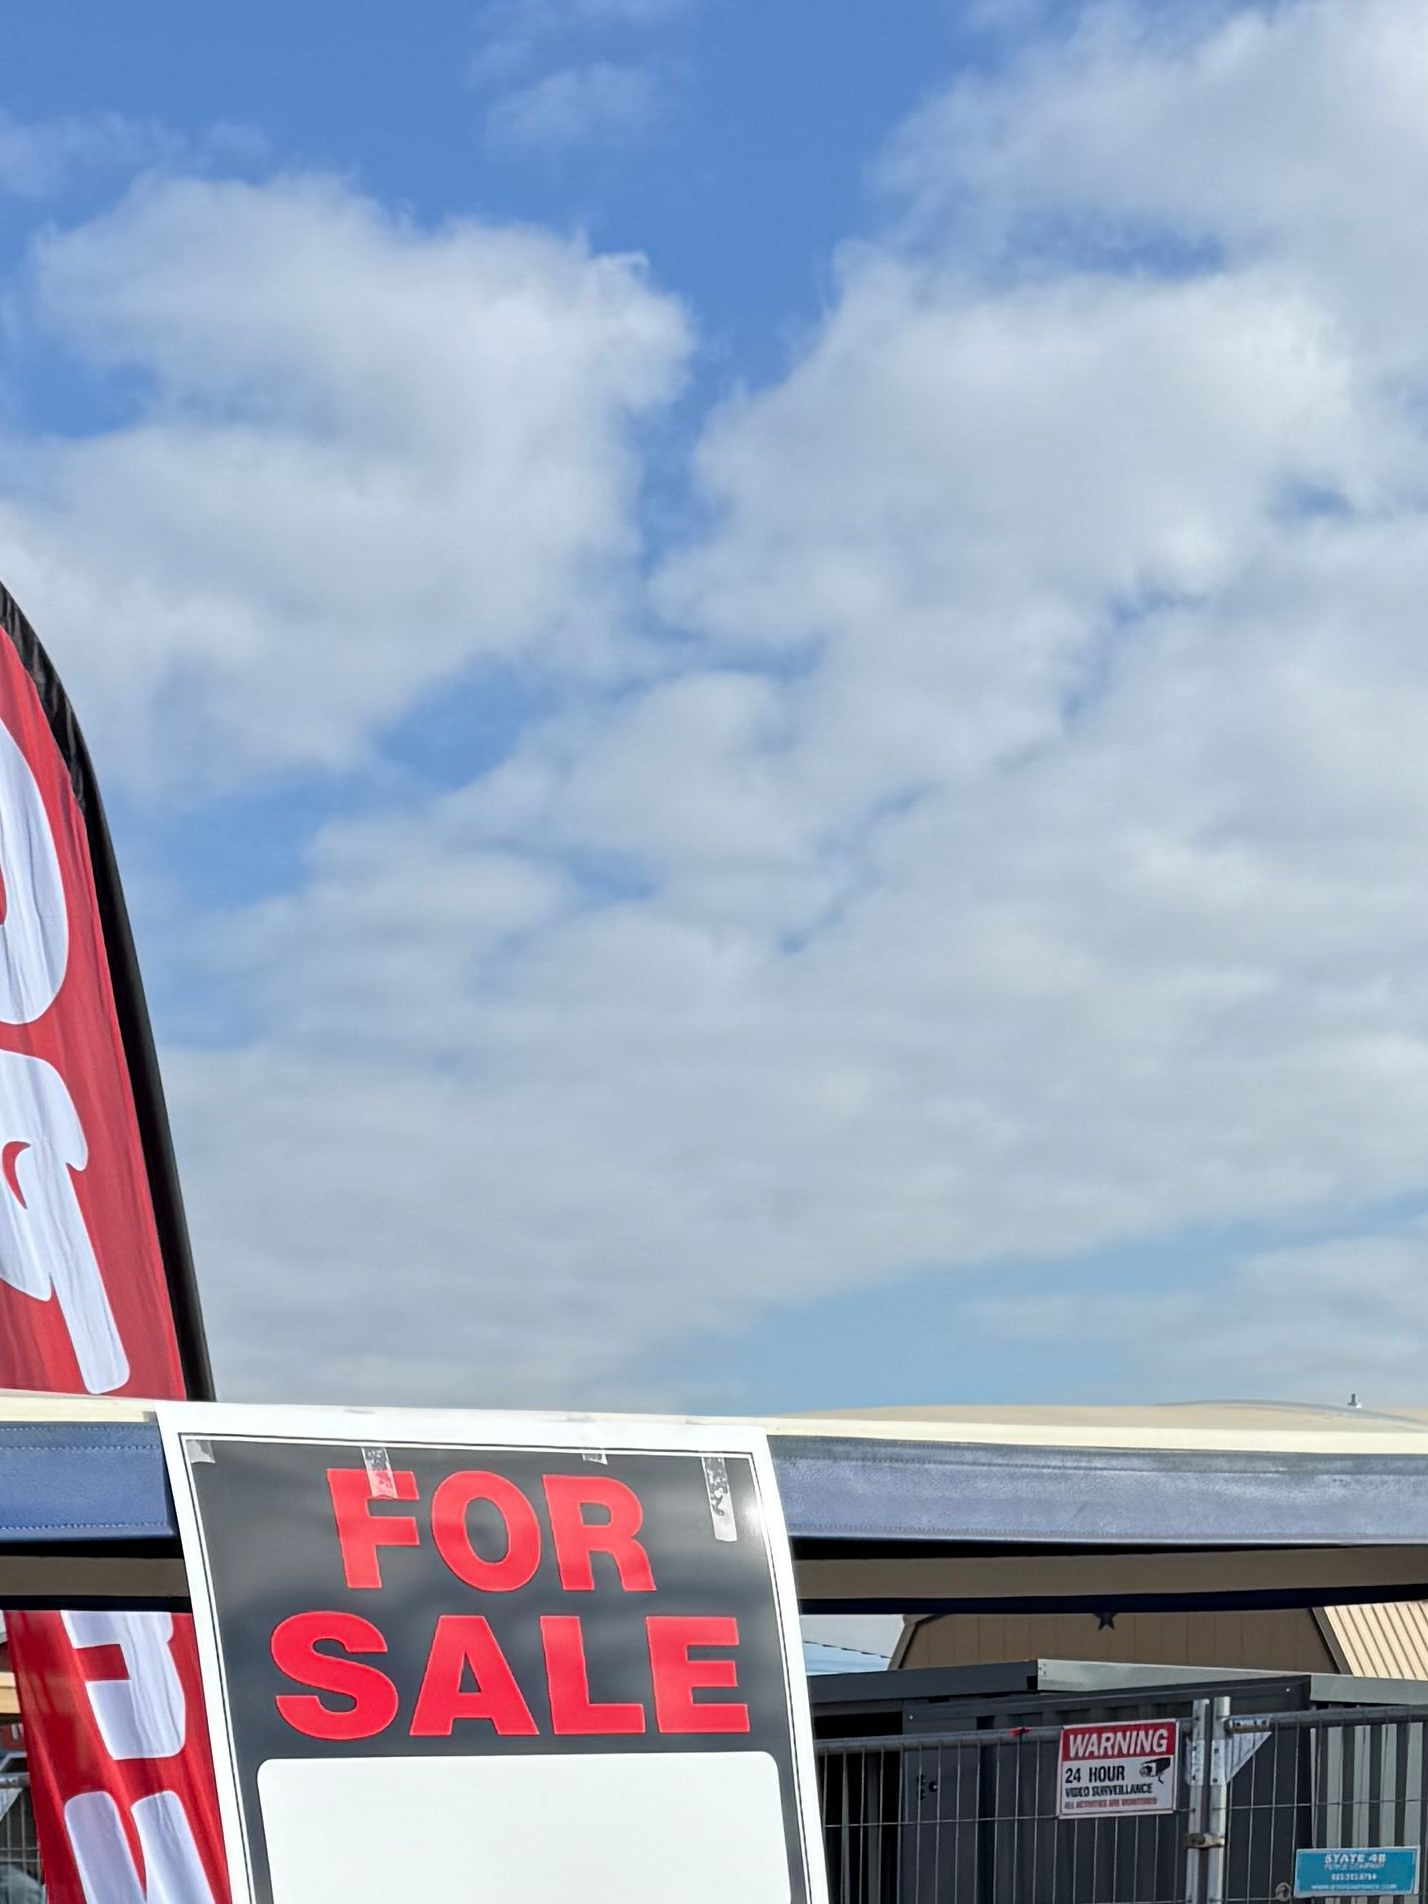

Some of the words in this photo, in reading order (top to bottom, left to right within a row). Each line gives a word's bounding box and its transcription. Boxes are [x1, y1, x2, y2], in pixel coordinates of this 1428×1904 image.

[326, 1467, 657, 1592] FOR
[270, 1611, 752, 1740] SALE
[1069, 1728, 1168, 1759] WARNING
[1065, 1768, 1081, 1784] 24
[1088, 1765, 1125, 1783] HOUR
[1065, 1786, 1090, 1798] VIDEO
